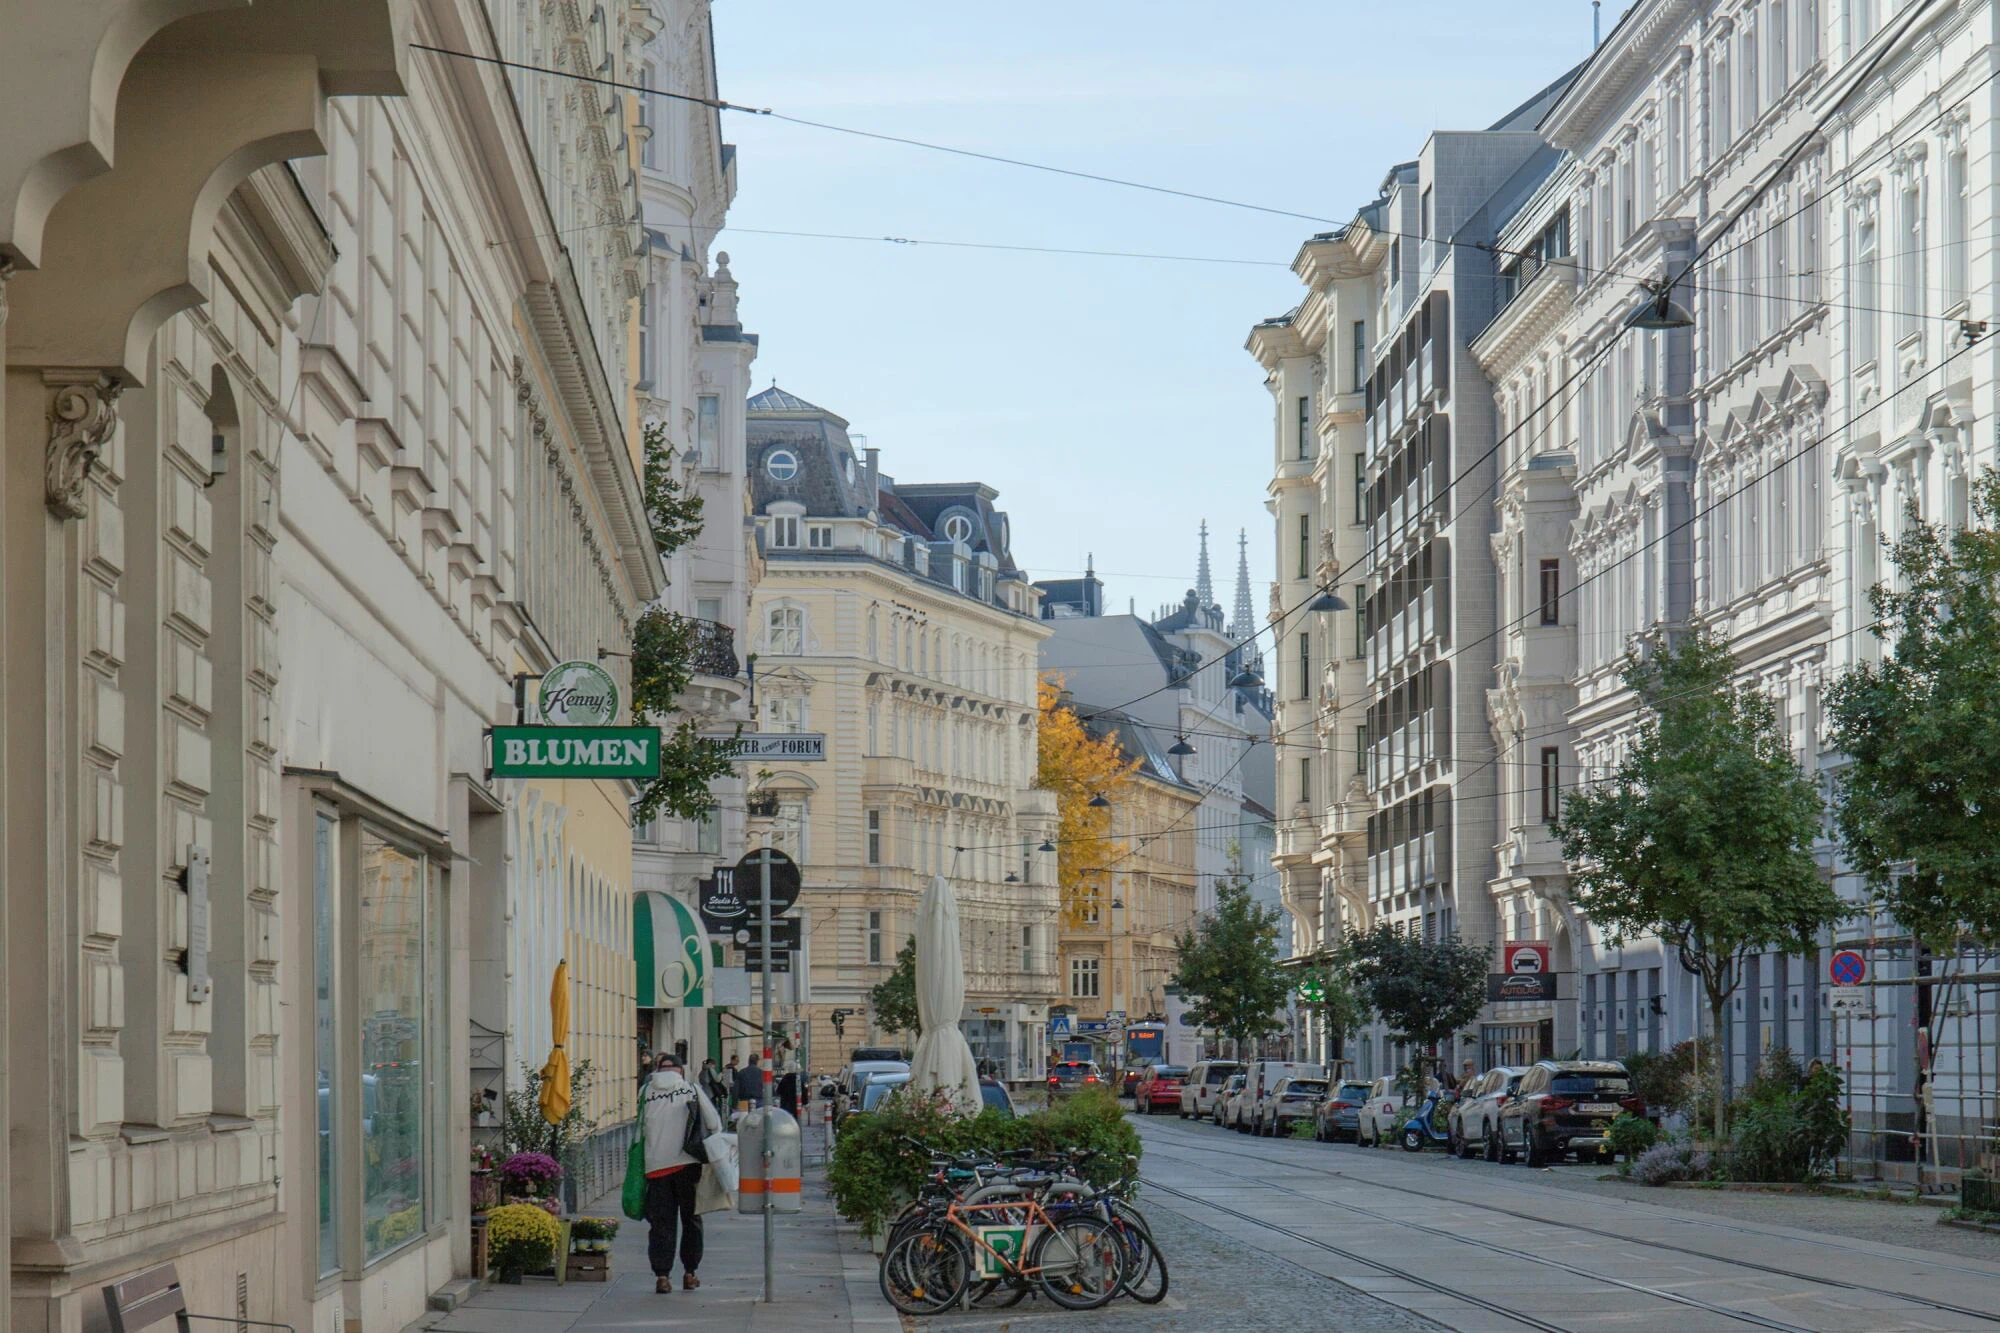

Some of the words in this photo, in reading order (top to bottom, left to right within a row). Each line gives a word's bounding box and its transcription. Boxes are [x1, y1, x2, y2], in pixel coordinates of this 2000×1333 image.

[541, 688, 615, 714] Kenny's
[503, 739, 649, 766] BLUMEN
[781, 740, 821, 753] FORUM
[708, 896, 731, 905] Studio
